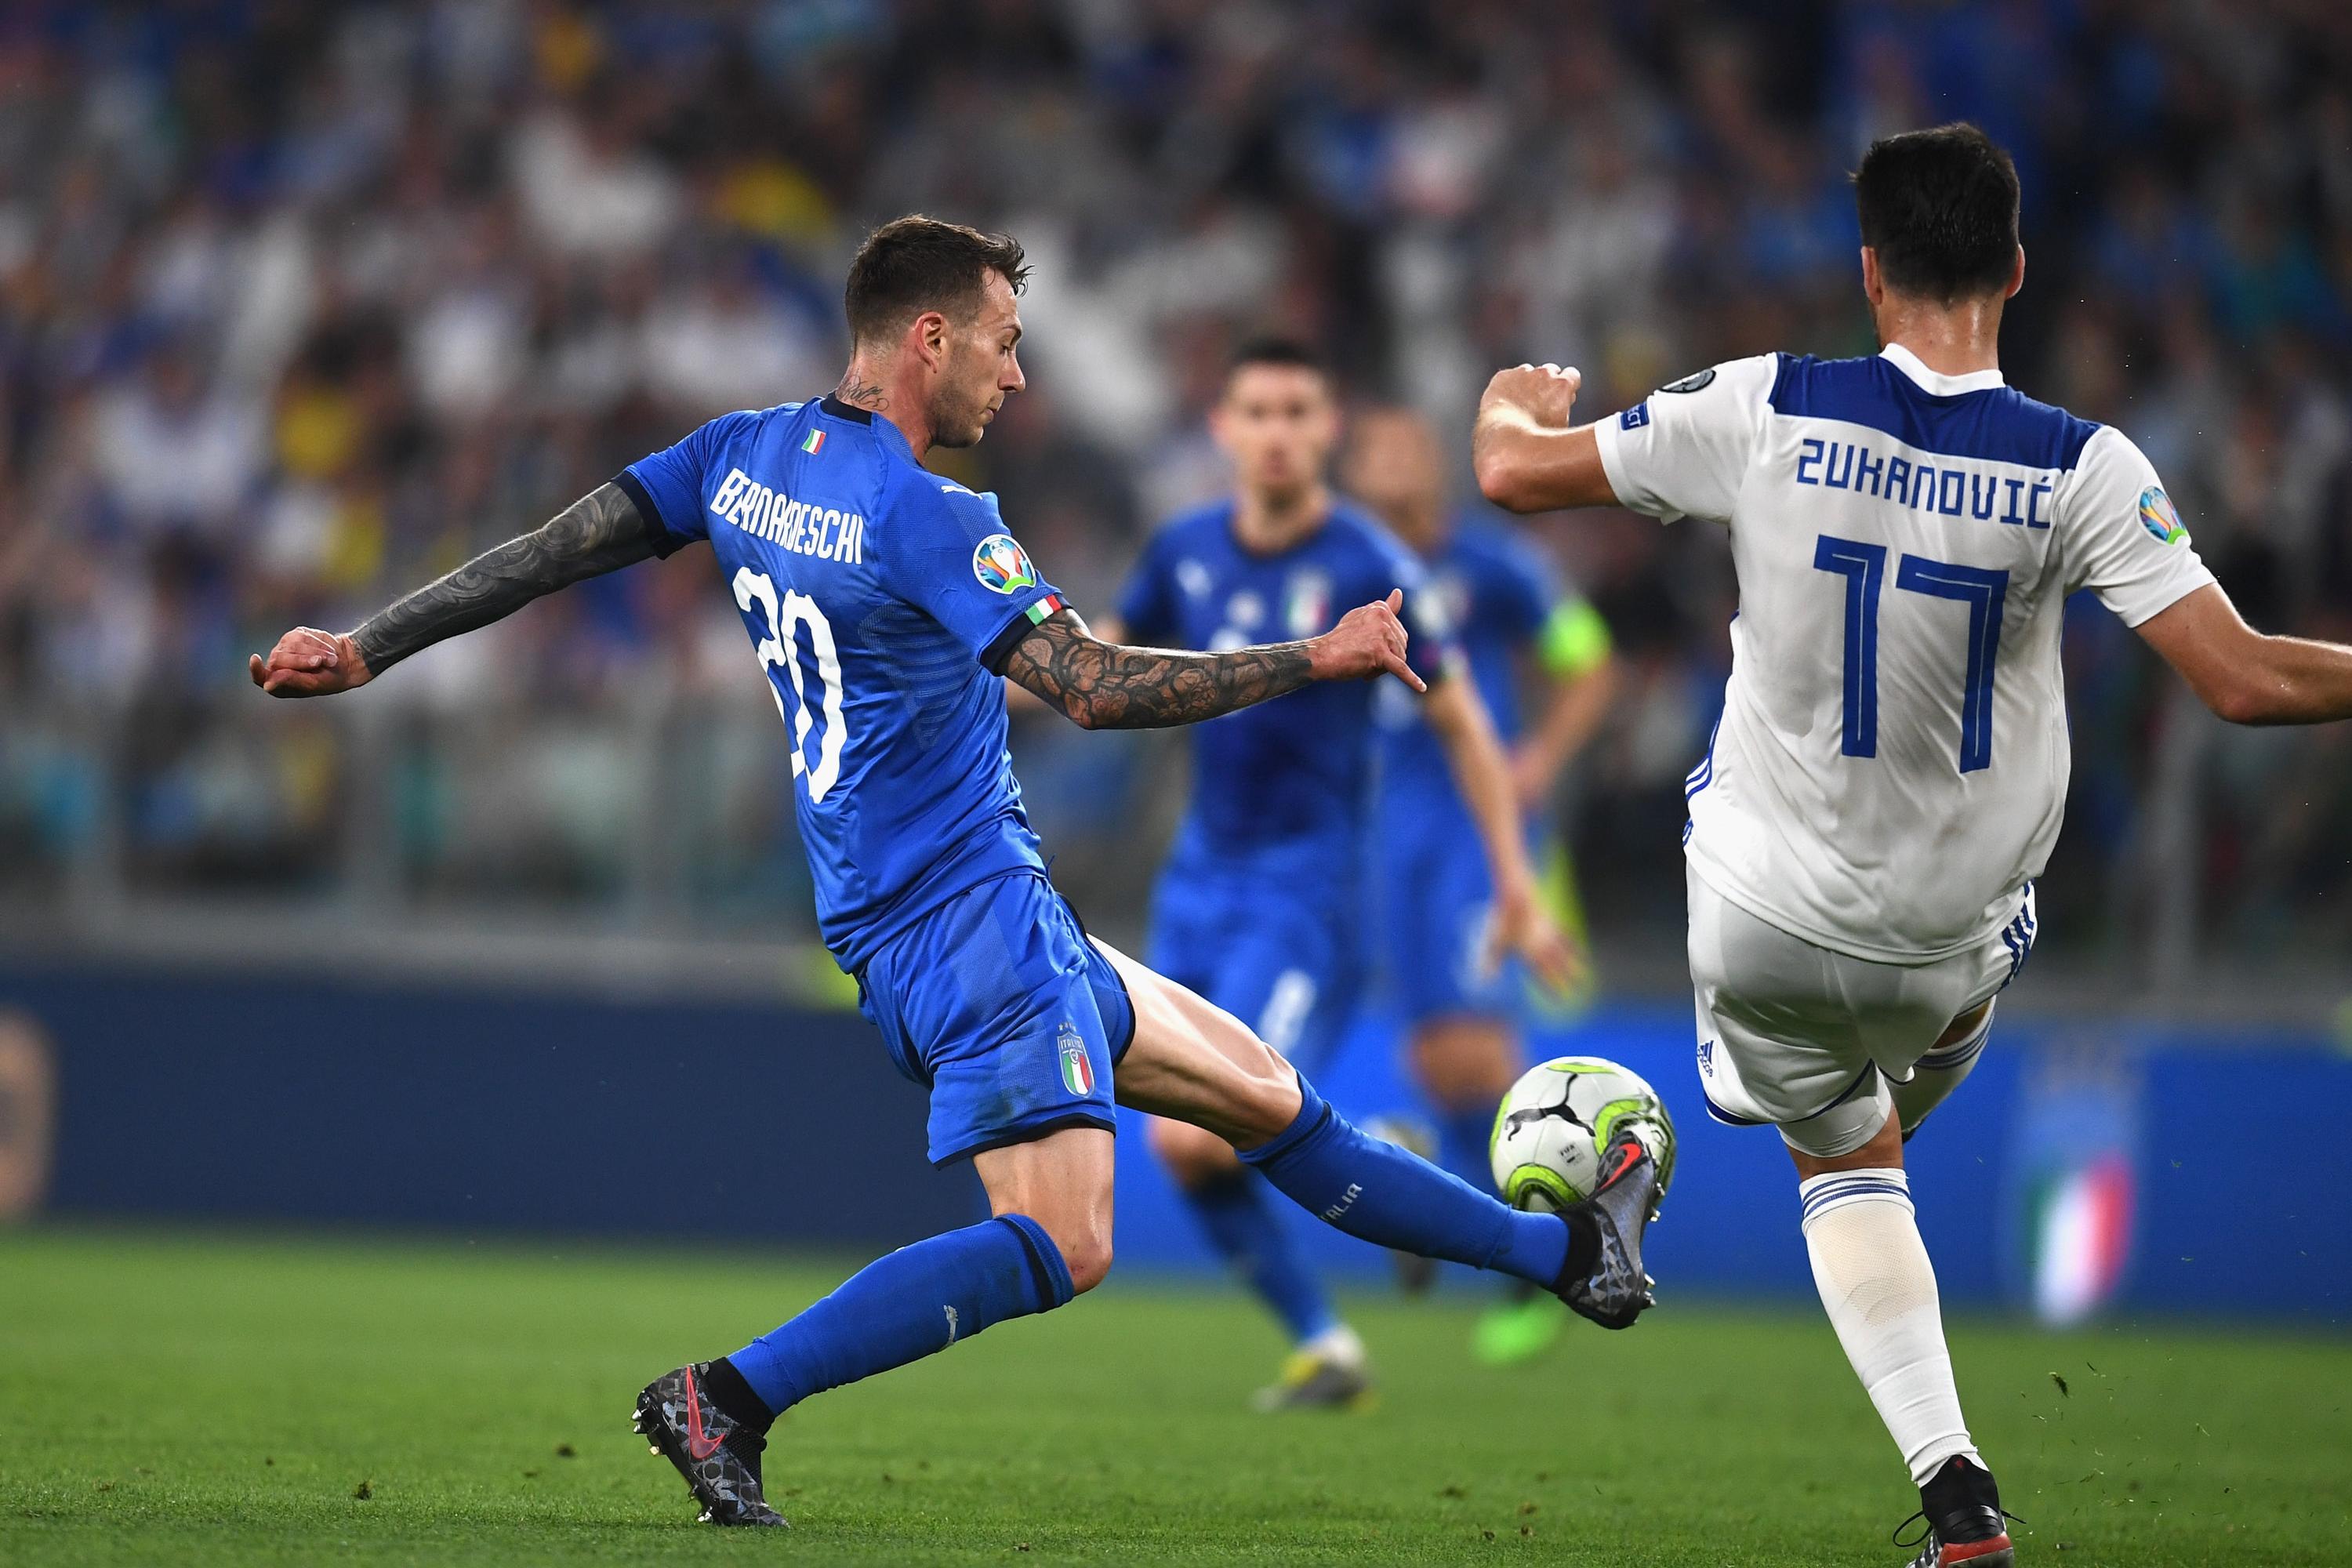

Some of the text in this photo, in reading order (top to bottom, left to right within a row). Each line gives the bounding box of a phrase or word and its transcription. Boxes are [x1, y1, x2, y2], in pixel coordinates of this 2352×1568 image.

[710, 468, 863, 564] BERNARDESCHI
[1797, 438, 2052, 529] ZUKANOVIĆ
[732, 566, 848, 804] 20
[1813, 535, 2009, 774] 17
[1320, 1182, 1363, 1221] ALIA
